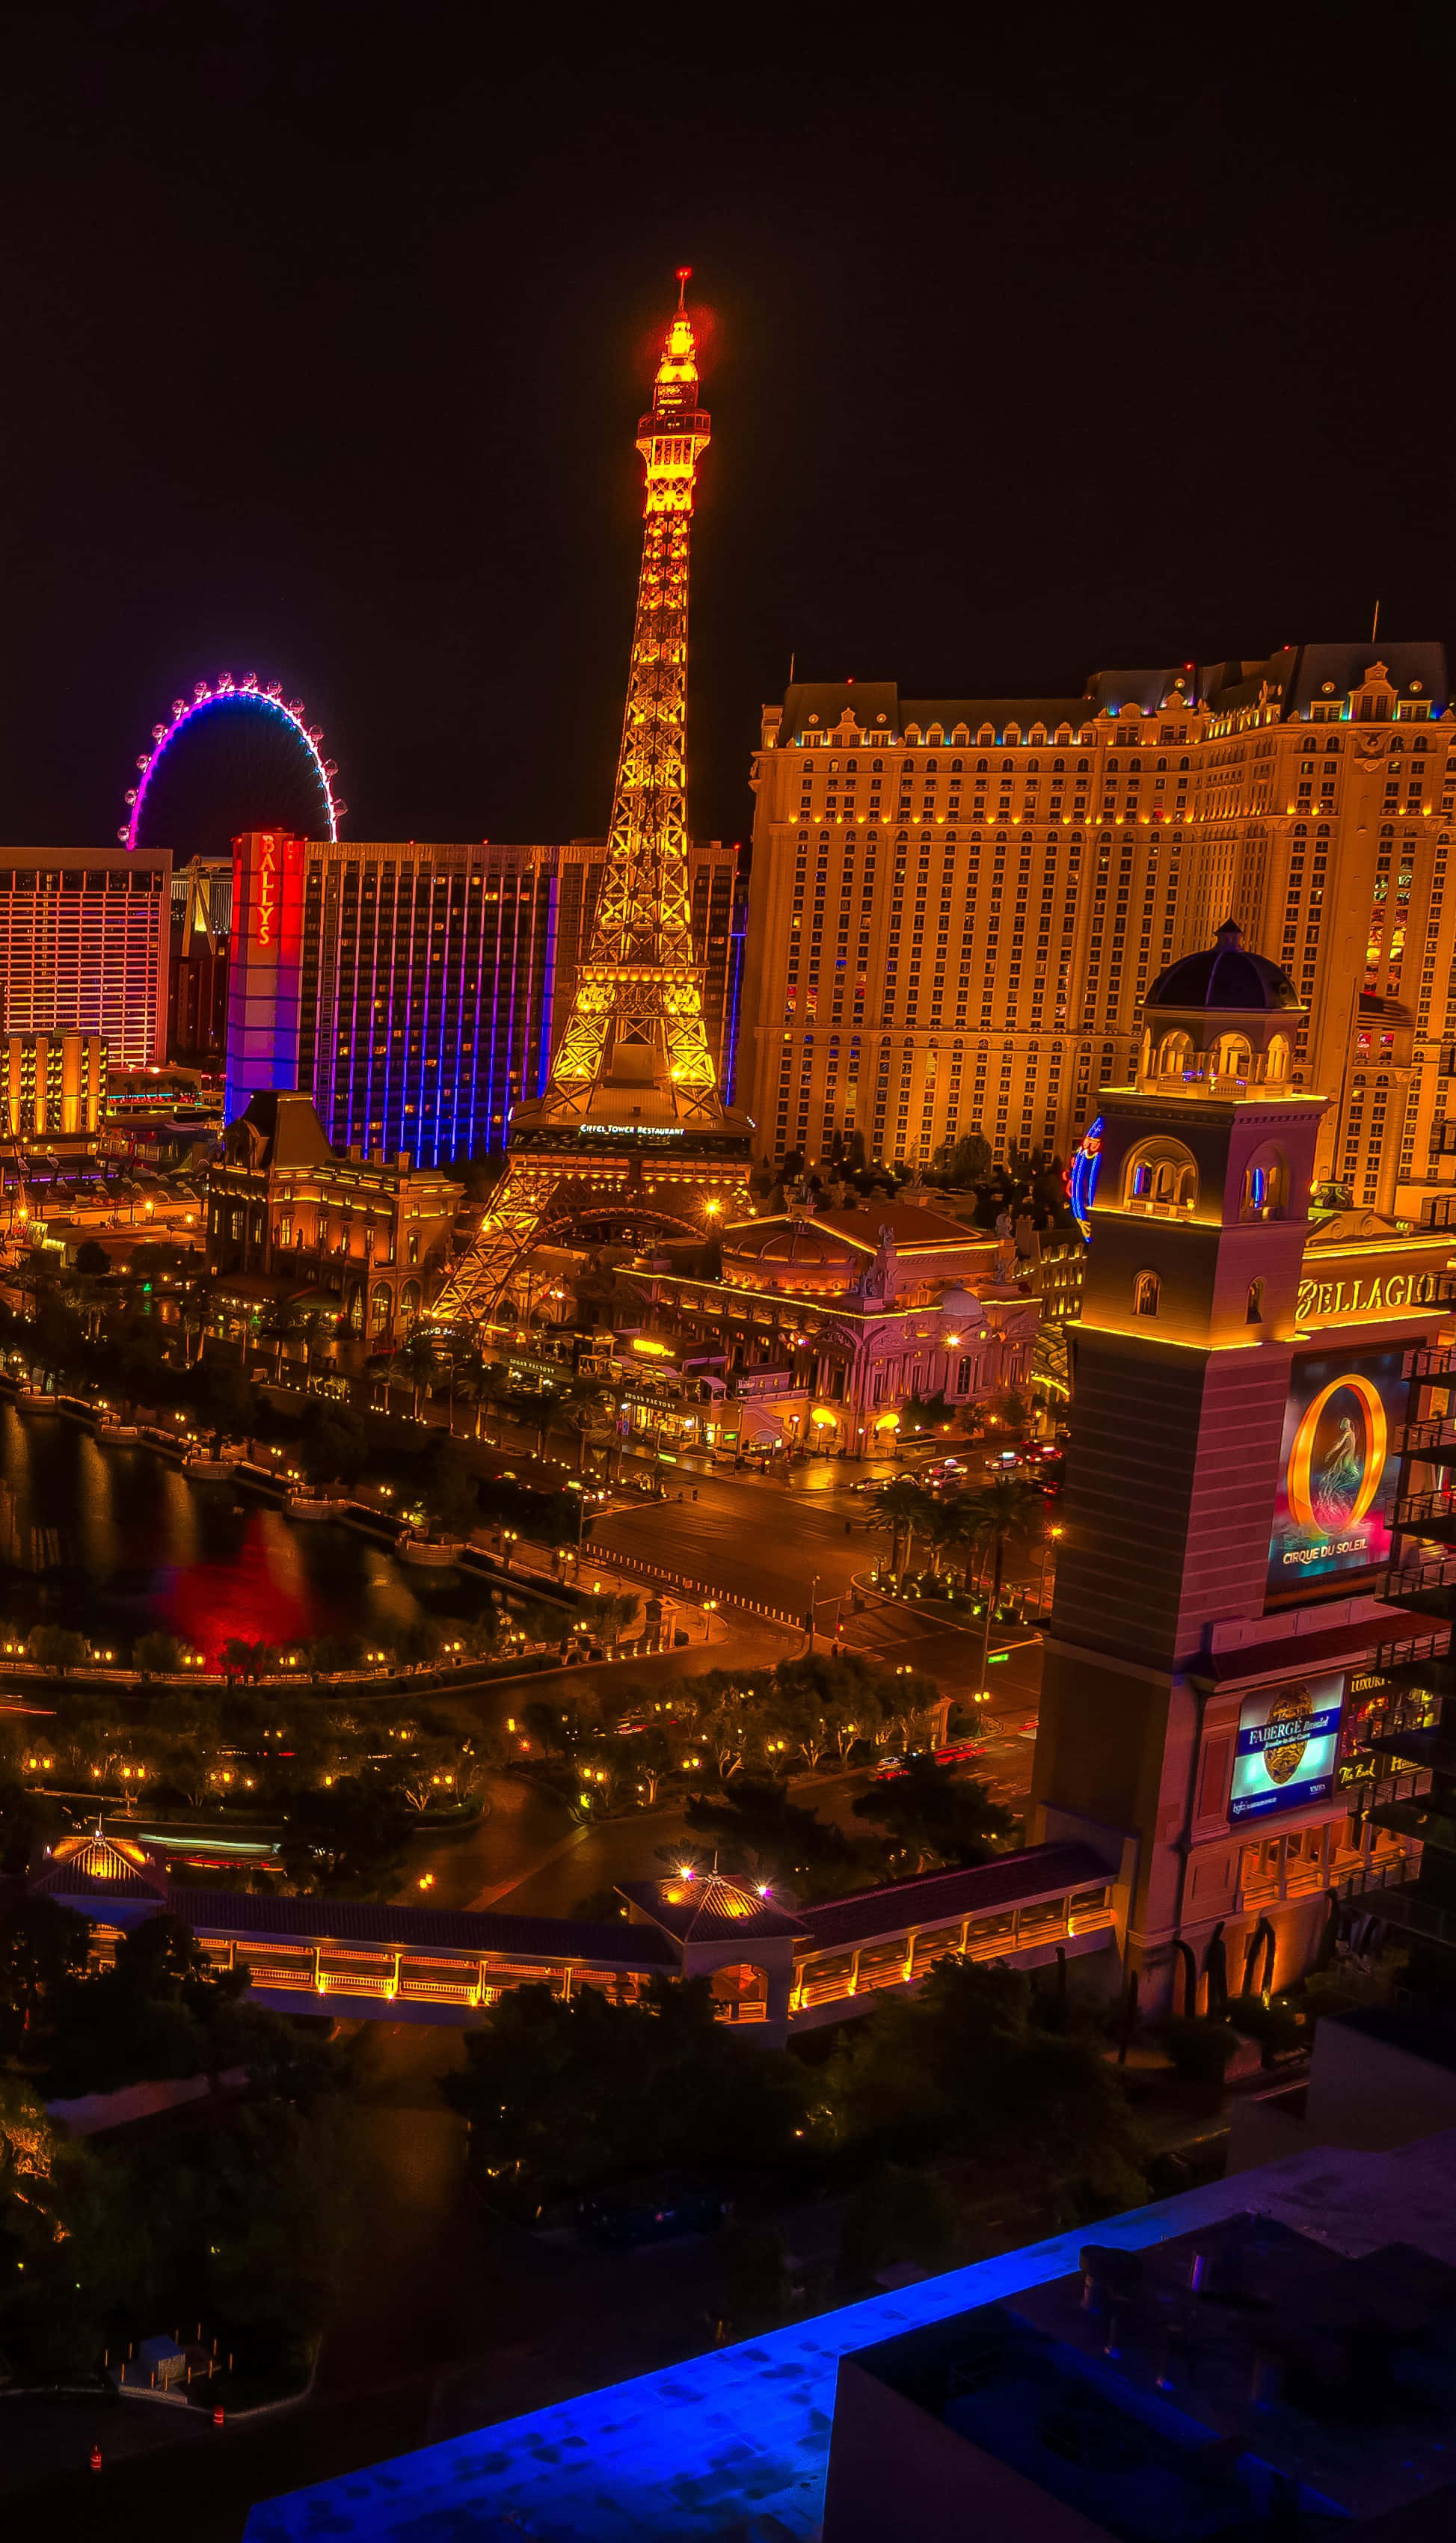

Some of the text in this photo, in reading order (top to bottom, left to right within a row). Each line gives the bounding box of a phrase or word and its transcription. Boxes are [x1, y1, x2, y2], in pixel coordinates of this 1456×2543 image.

[257, 835, 276, 945] BALLYS
[580, 1124, 685, 1135] EIFFEL TOWER RESTAURANT
[1295, 1273, 1436, 1321] BELLAGIO
[1283, 1538, 1368, 1565] CIRQUE DU SOLEIL
[1249, 1717, 1303, 1745] FABERGÉ
